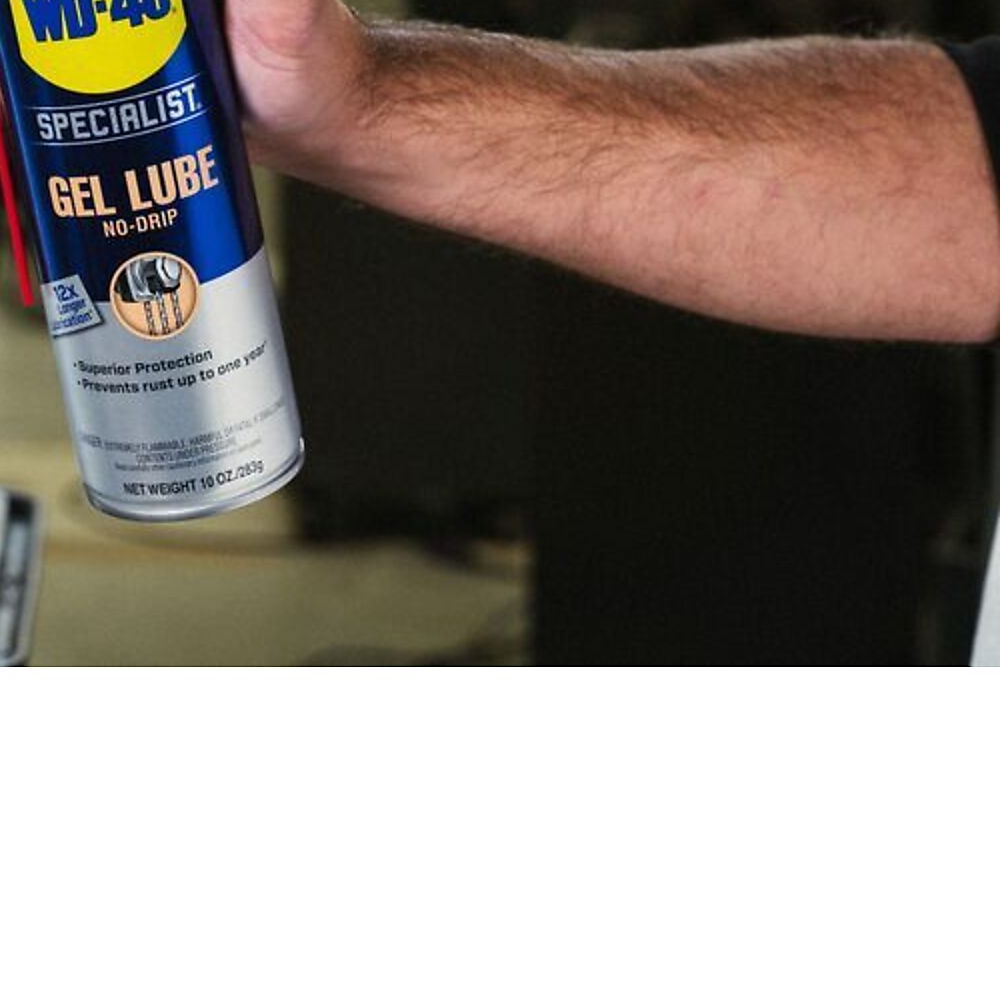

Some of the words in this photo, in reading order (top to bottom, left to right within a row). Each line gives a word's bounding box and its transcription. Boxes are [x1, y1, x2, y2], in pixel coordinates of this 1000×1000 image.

[37, 82, 201, 141] SPECIALIST
[48, 175, 117, 218] GEL
[123, 144, 220, 212] LUBE
[102, 208, 179, 239] NO-DRIP
[78, 360, 132, 377] Superior
[134, 349, 214, 376] Protection
[81, 377, 140, 395] Prevents
[142, 376, 174, 394] rust
[177, 373, 197, 388] up
[200, 368, 215, 383] to
[217, 356, 241, 376] one
[123, 481, 146, 497] NET
[148, 477, 198, 497] WEIGHT
[200, 474, 215, 490] 10
